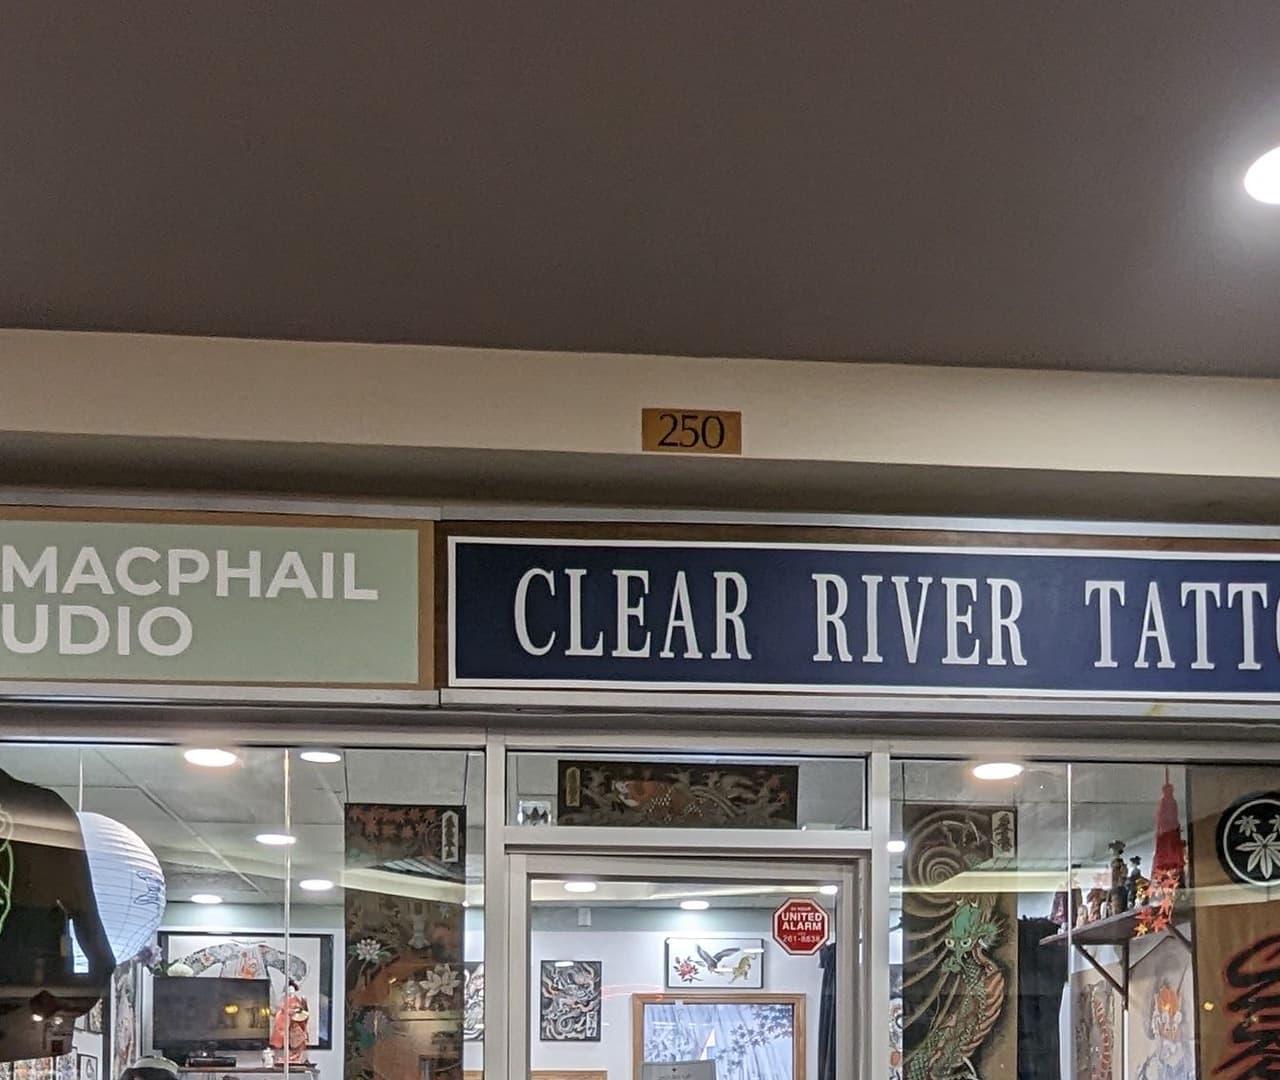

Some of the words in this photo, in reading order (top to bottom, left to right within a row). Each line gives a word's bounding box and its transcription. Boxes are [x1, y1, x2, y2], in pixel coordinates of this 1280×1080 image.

[657, 413, 725, 449] 250
[1, 544, 380, 602] MACPHAIL
[512, 565, 753, 662] CLEAR
[811, 571, 1029, 667] RIVER
[781, 912, 823, 921] UNITED
[782, 922, 822, 931] ALARM
